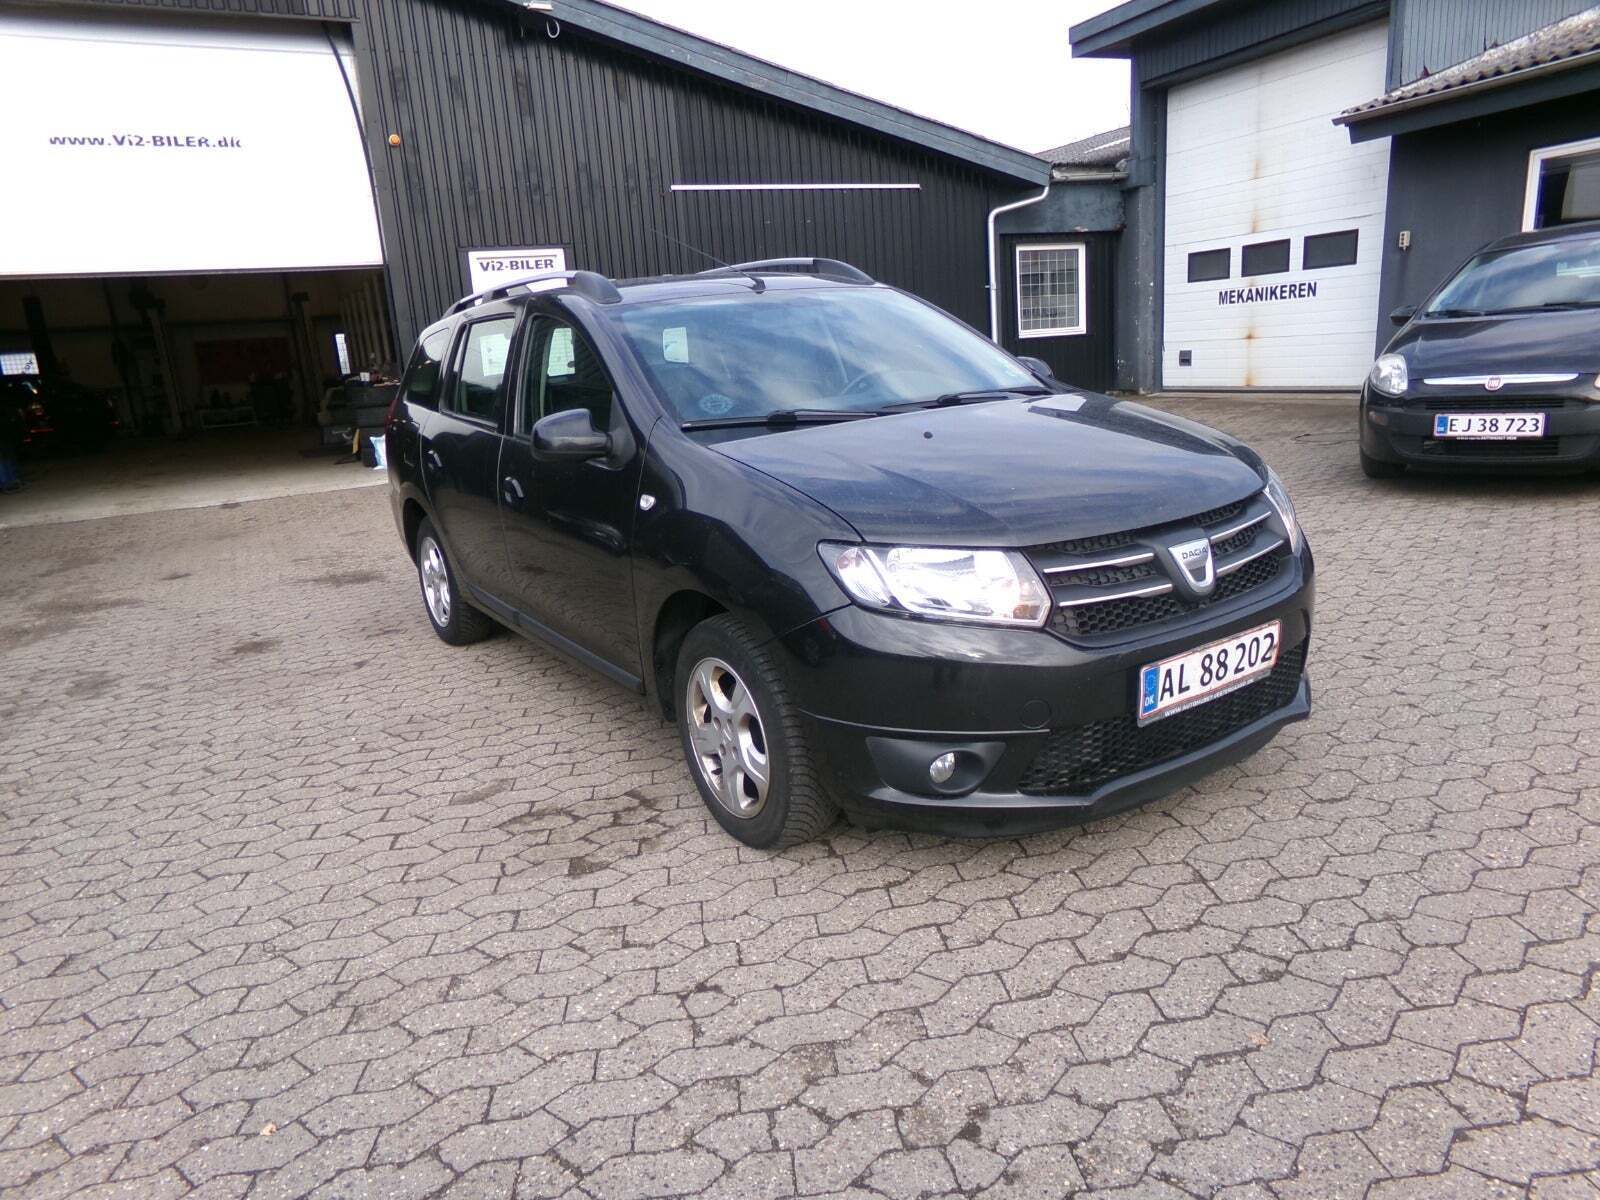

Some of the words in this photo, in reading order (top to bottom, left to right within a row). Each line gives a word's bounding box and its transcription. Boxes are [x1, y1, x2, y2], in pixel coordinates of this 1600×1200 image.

[49, 134, 242, 148] www.Vi2-BILER.dk
[480, 258, 554, 272] Vi2-BILER
[1218, 281, 1317, 305] MEKANIKEREN
[1477, 418, 1499, 432] 38
[1504, 418, 1540, 432] 723
[1181, 546, 1207, 559] DACIA
[1160, 663, 1190, 702] AL
[1200, 648, 1228, 687] 88
[1233, 632, 1275, 675] 202
[1144, 694, 1155, 706] DK
